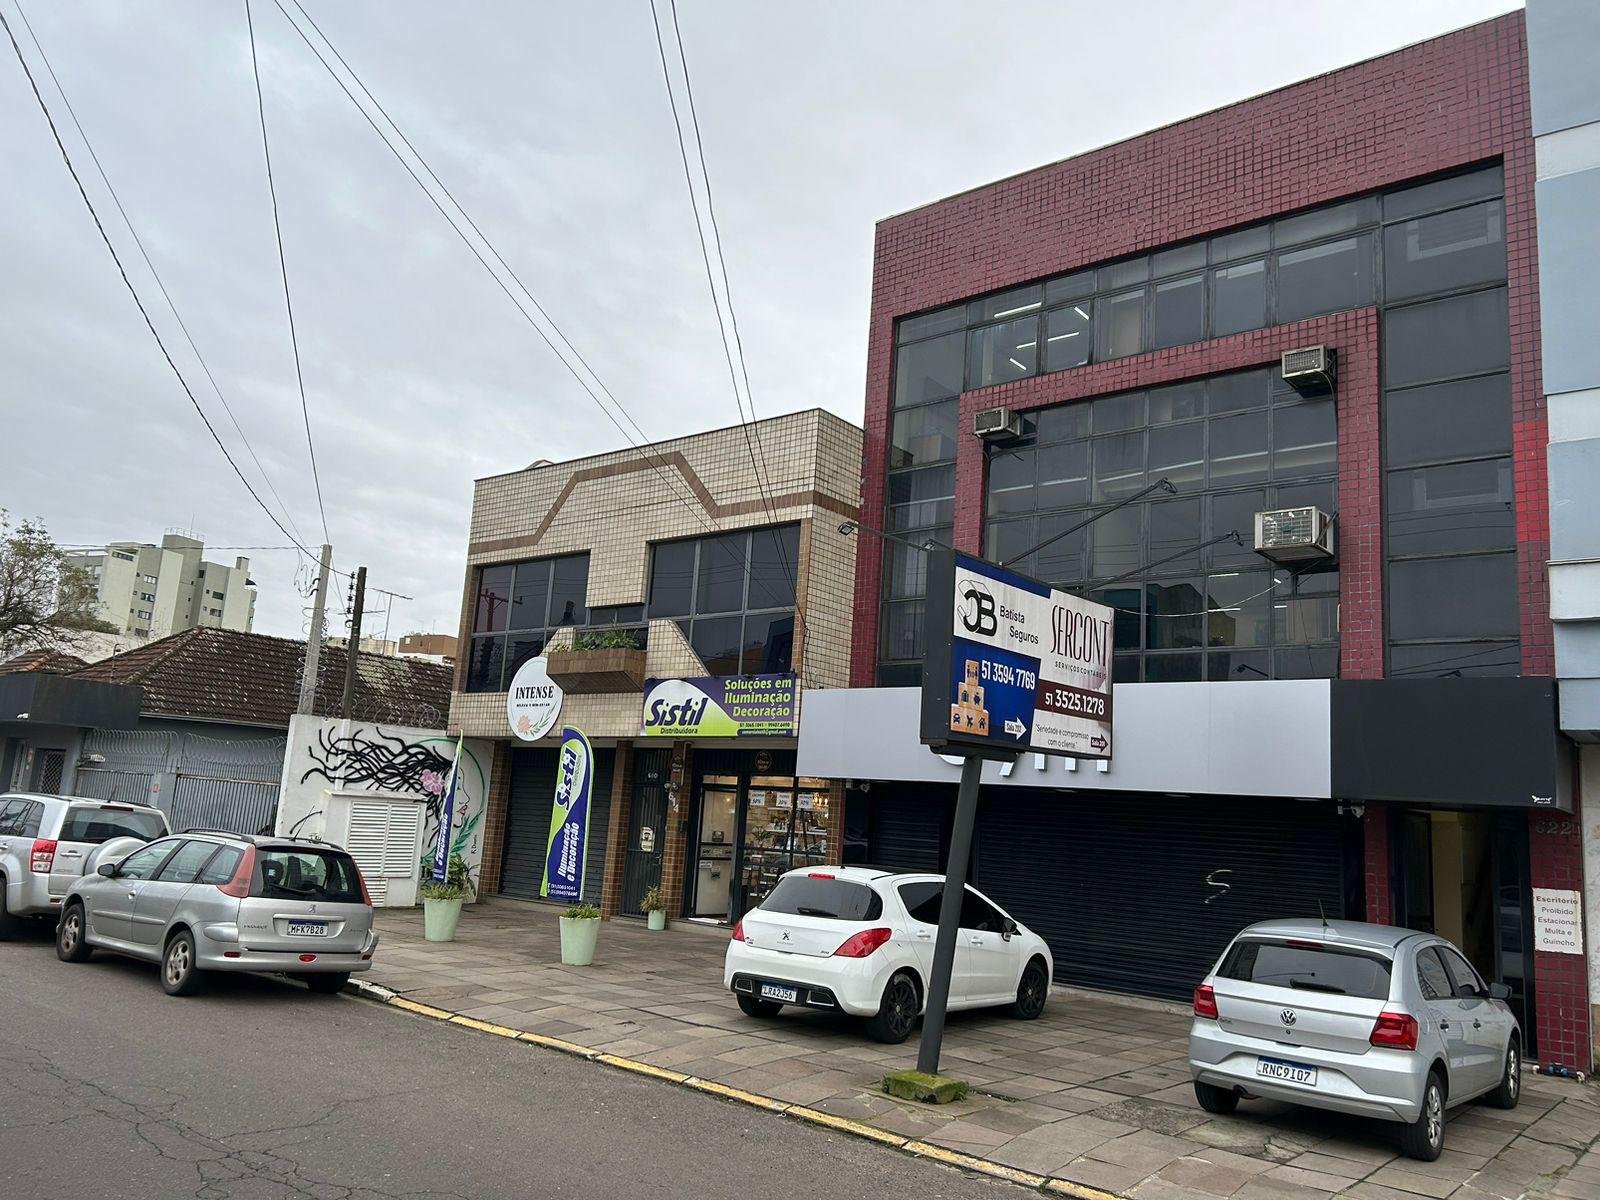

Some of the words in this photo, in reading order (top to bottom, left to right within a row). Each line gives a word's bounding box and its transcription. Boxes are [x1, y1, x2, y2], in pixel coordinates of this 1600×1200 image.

[1000, 605, 1025, 624] Batista
[1009, 625, 1039, 644] Seguros
[1050, 605, 1110, 667] SERCONT
[981, 660, 991, 680] 51
[992, 662, 1014, 686] 3594
[1015, 668, 1036, 690] 7769
[1054, 661, 1080, 673] SERVIÇOS
[515, 685, 555, 700] INTENSE
[724, 677, 772, 693] Soluções
[775, 678, 792, 689] em
[724, 690, 791, 706] Iluminação
[1045, 692, 1053, 706] 51
[1055, 689, 1105, 716] 3525.1278
[645, 697, 709, 727] Sistil
[733, 704, 790, 719] Decoração
[660, 727, 698, 735] Distribuidora
[556, 746, 577, 811] Sistil
[557, 822, 571, 878] Iluminação
[566, 822, 580, 875] Decoração
[566, 874, 575, 882] e
[1541, 906, 1574, 915] Proibido
[290, 925, 324, 935] MFK7B28
[1544, 927, 1566, 935] Multa
[1542, 937, 1575, 947] Guincho
[763, 985, 793, 1000] LRA2J56
[1261, 1062, 1312, 1082] RNC9I07
